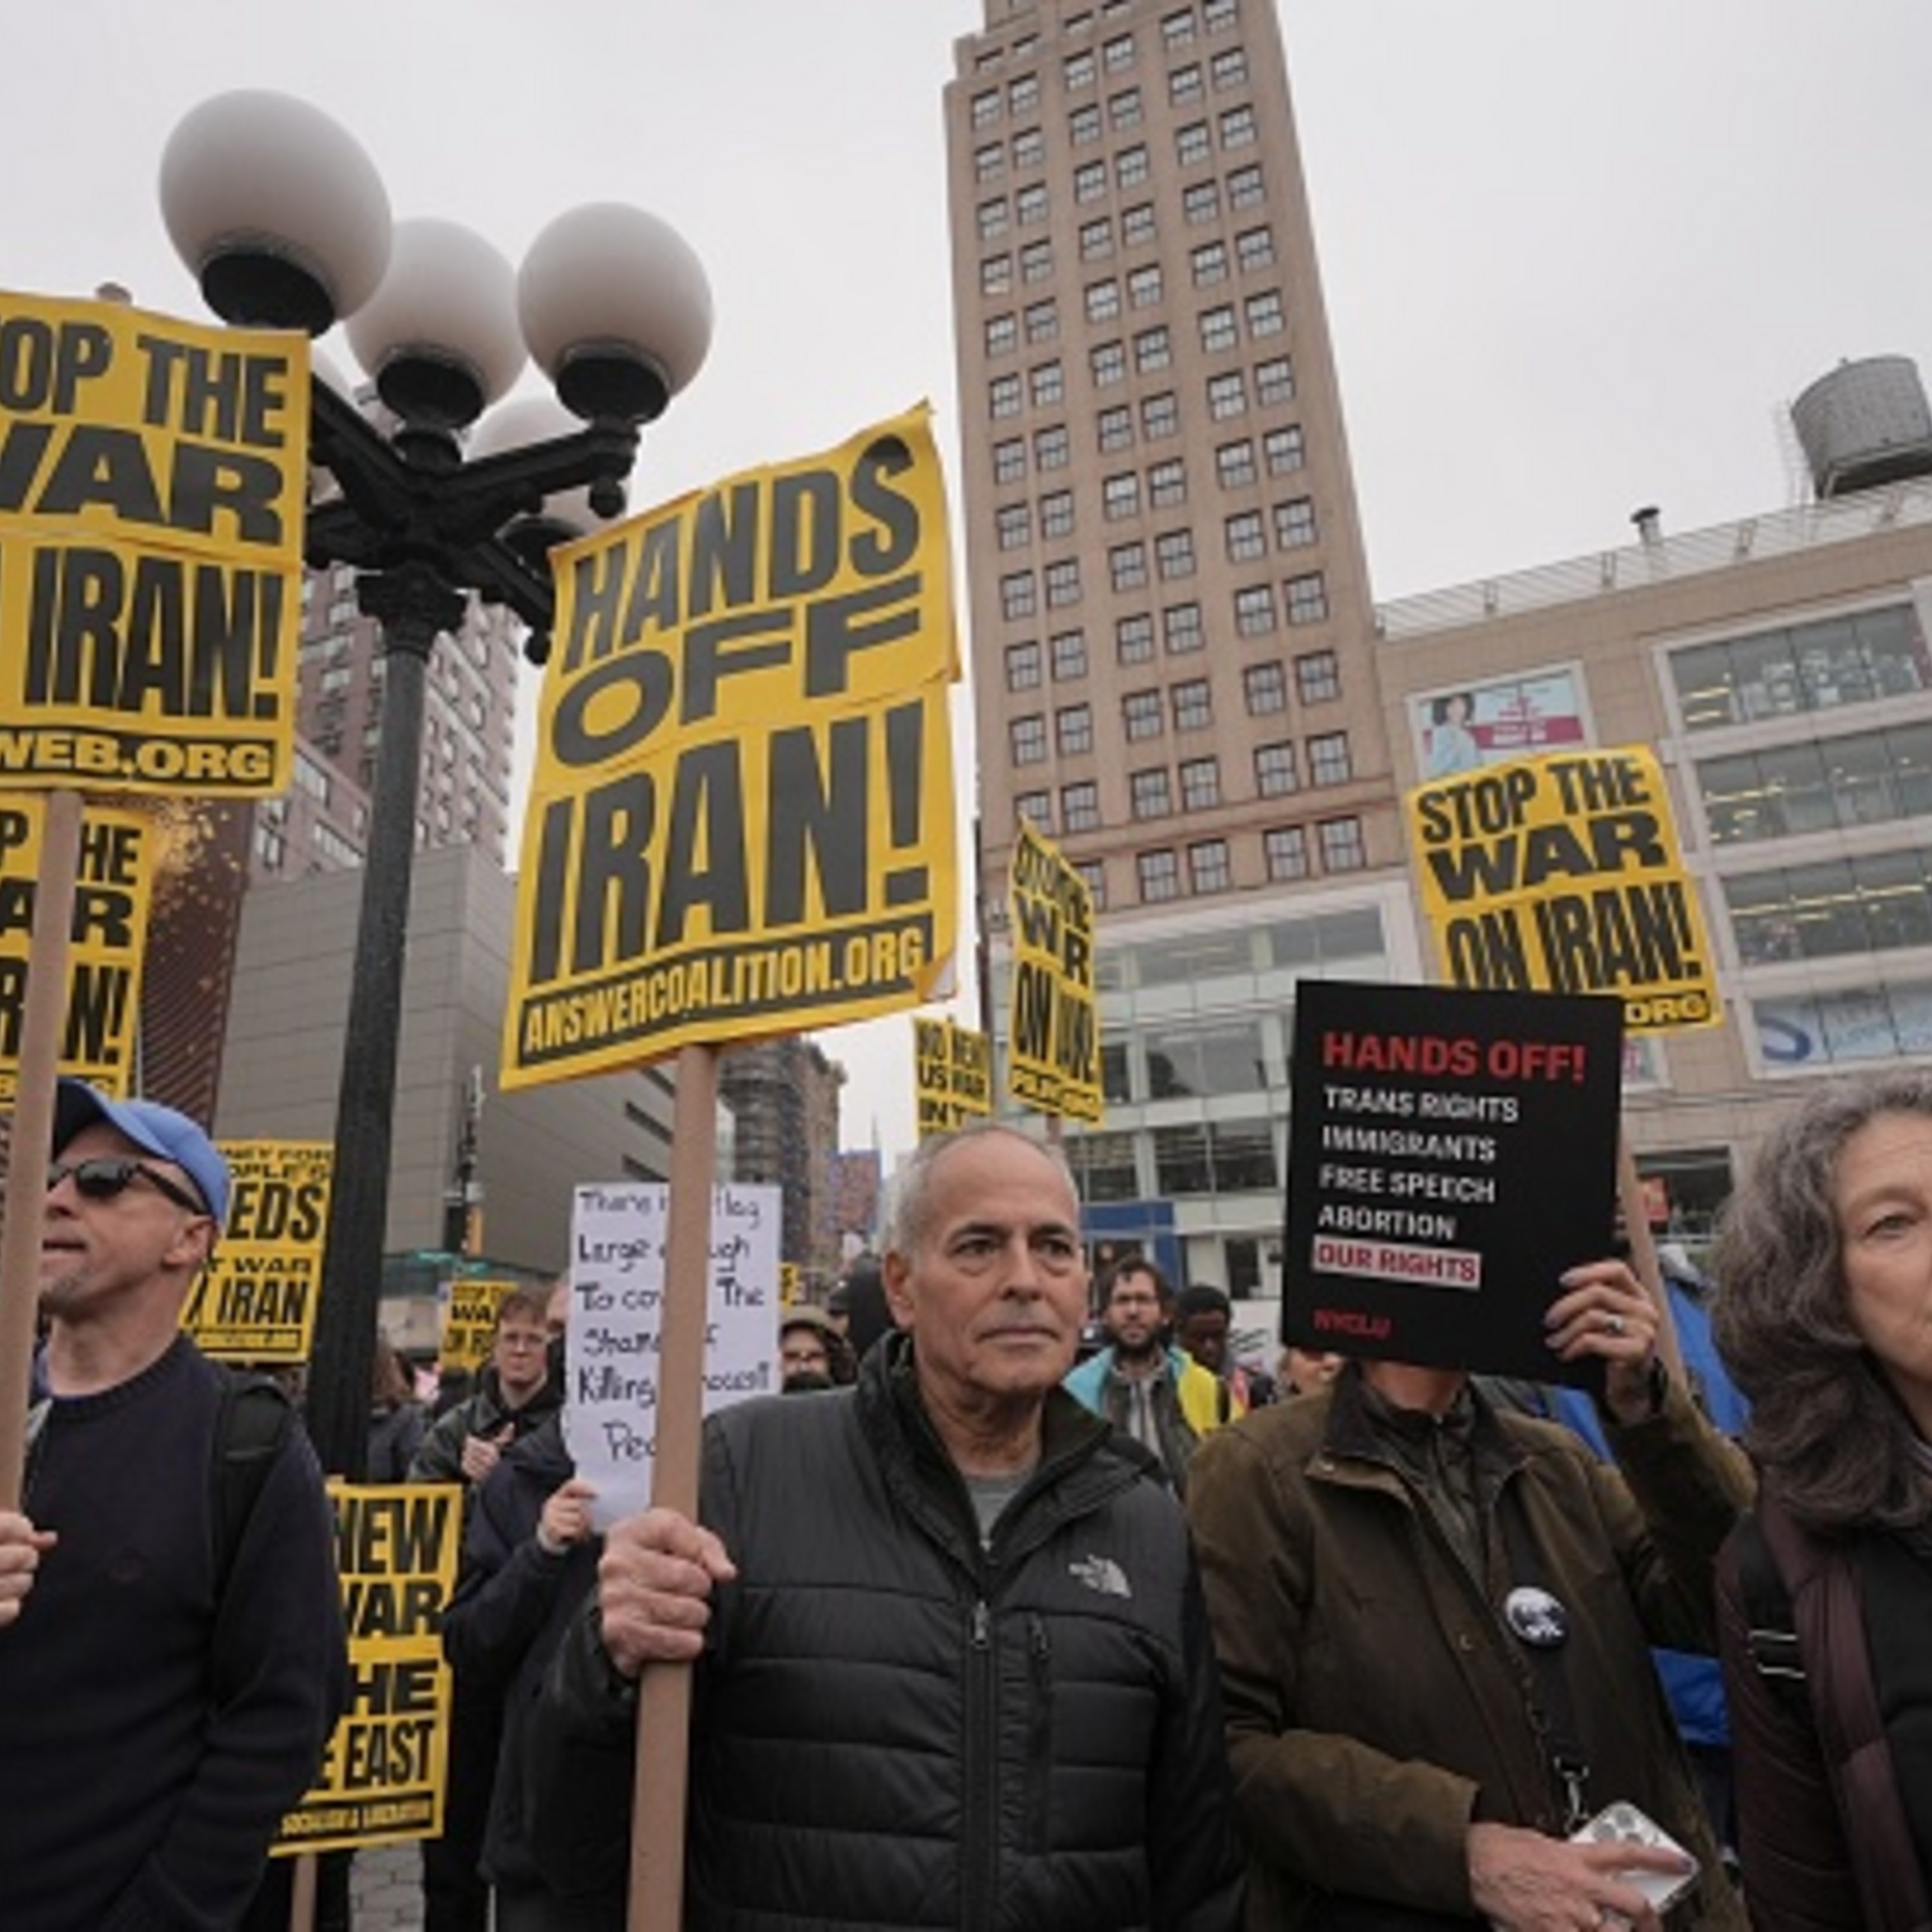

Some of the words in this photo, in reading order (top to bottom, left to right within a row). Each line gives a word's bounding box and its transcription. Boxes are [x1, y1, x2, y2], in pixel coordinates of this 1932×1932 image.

[137, 335, 287, 448] THE
[562, 433, 920, 675] HANDS
[24, 546, 283, 720] IRAN!
[551, 572, 921, 767] OFF
[1418, 768, 1537, 842] STOP
[1546, 759, 1651, 815] THE
[77, 824, 141, 886] HE
[528, 698, 928, 986] IRAN!
[1428, 811, 1667, 900] WAR
[0, 877, 133, 947] AR
[1446, 909, 1532, 990] ON
[1534, 881, 1702, 994] IRAN!
[524, 925, 923, 1052] ANSWERCOALITION.ORG
[918, 1061, 948, 1093] US
[1322, 1032, 1477, 1075] HANDS
[1488, 1041, 1586, 1084] OFF!
[1325, 1086, 1415, 1117] TRANS
[1419, 1094, 1519, 1122] RIGHTS
[1322, 1126, 1497, 1162] IMMIGRANTS
[227, 1181, 324, 1243] EDS
[1319, 1164, 1383, 1194] FREE
[1390, 1171, 1495, 1203] SPEECH
[579, 1233, 650, 1273] Large
[1318, 1205, 1457, 1240] ABORTION
[235, 1258, 312, 1273] WAR
[576, 1282, 614, 1311] To
[716, 1276, 764, 1306] The
[1318, 1243, 1372, 1269] OUR
[1379, 1247, 1477, 1283] RIGHTS
[216, 1278, 308, 1324] IRAN
[351, 1659, 438, 1716] HE
[344, 1719, 435, 1790] EAST
